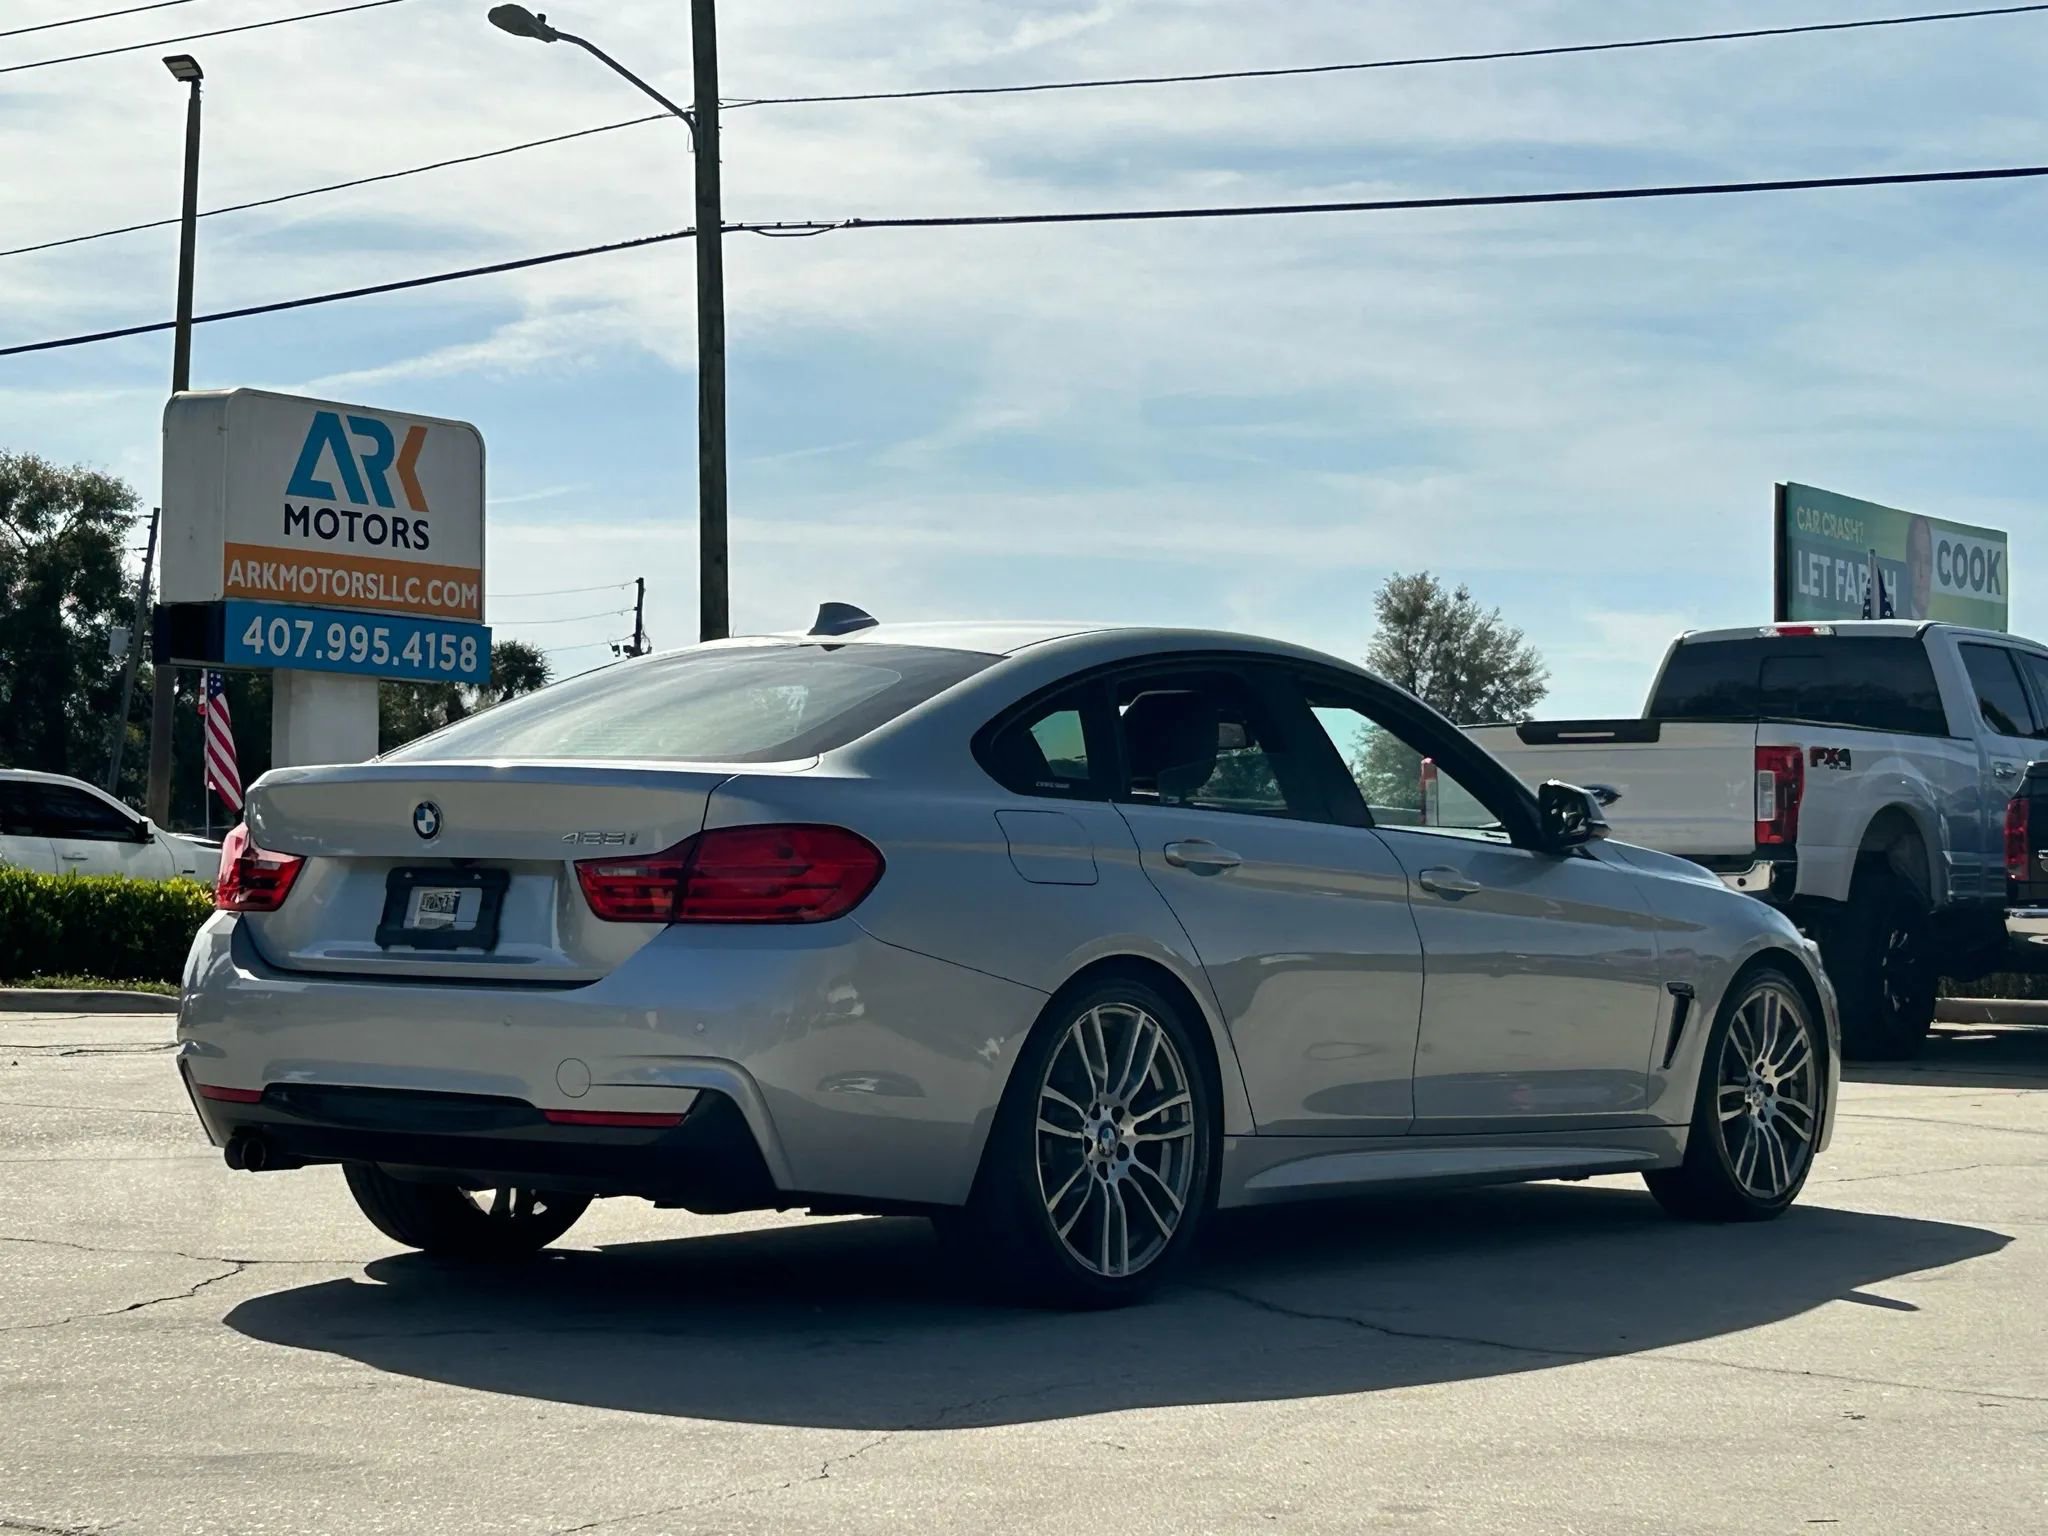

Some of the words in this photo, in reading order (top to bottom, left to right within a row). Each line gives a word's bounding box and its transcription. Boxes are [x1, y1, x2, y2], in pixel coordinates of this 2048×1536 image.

[285, 410, 430, 513] ARK
[283, 503, 430, 551] MOTORS
[1796, 505, 1820, 534] CAR
[227, 560, 478, 609] ARKMOTORSLLC.COM
[1798, 550, 1831, 598] LET
[1835, 558, 1897, 612] FARH
[1936, 539, 2001, 595] COOK
[242, 616, 478, 673] 407.995.4158
[1809, 745, 1852, 771] FX4
